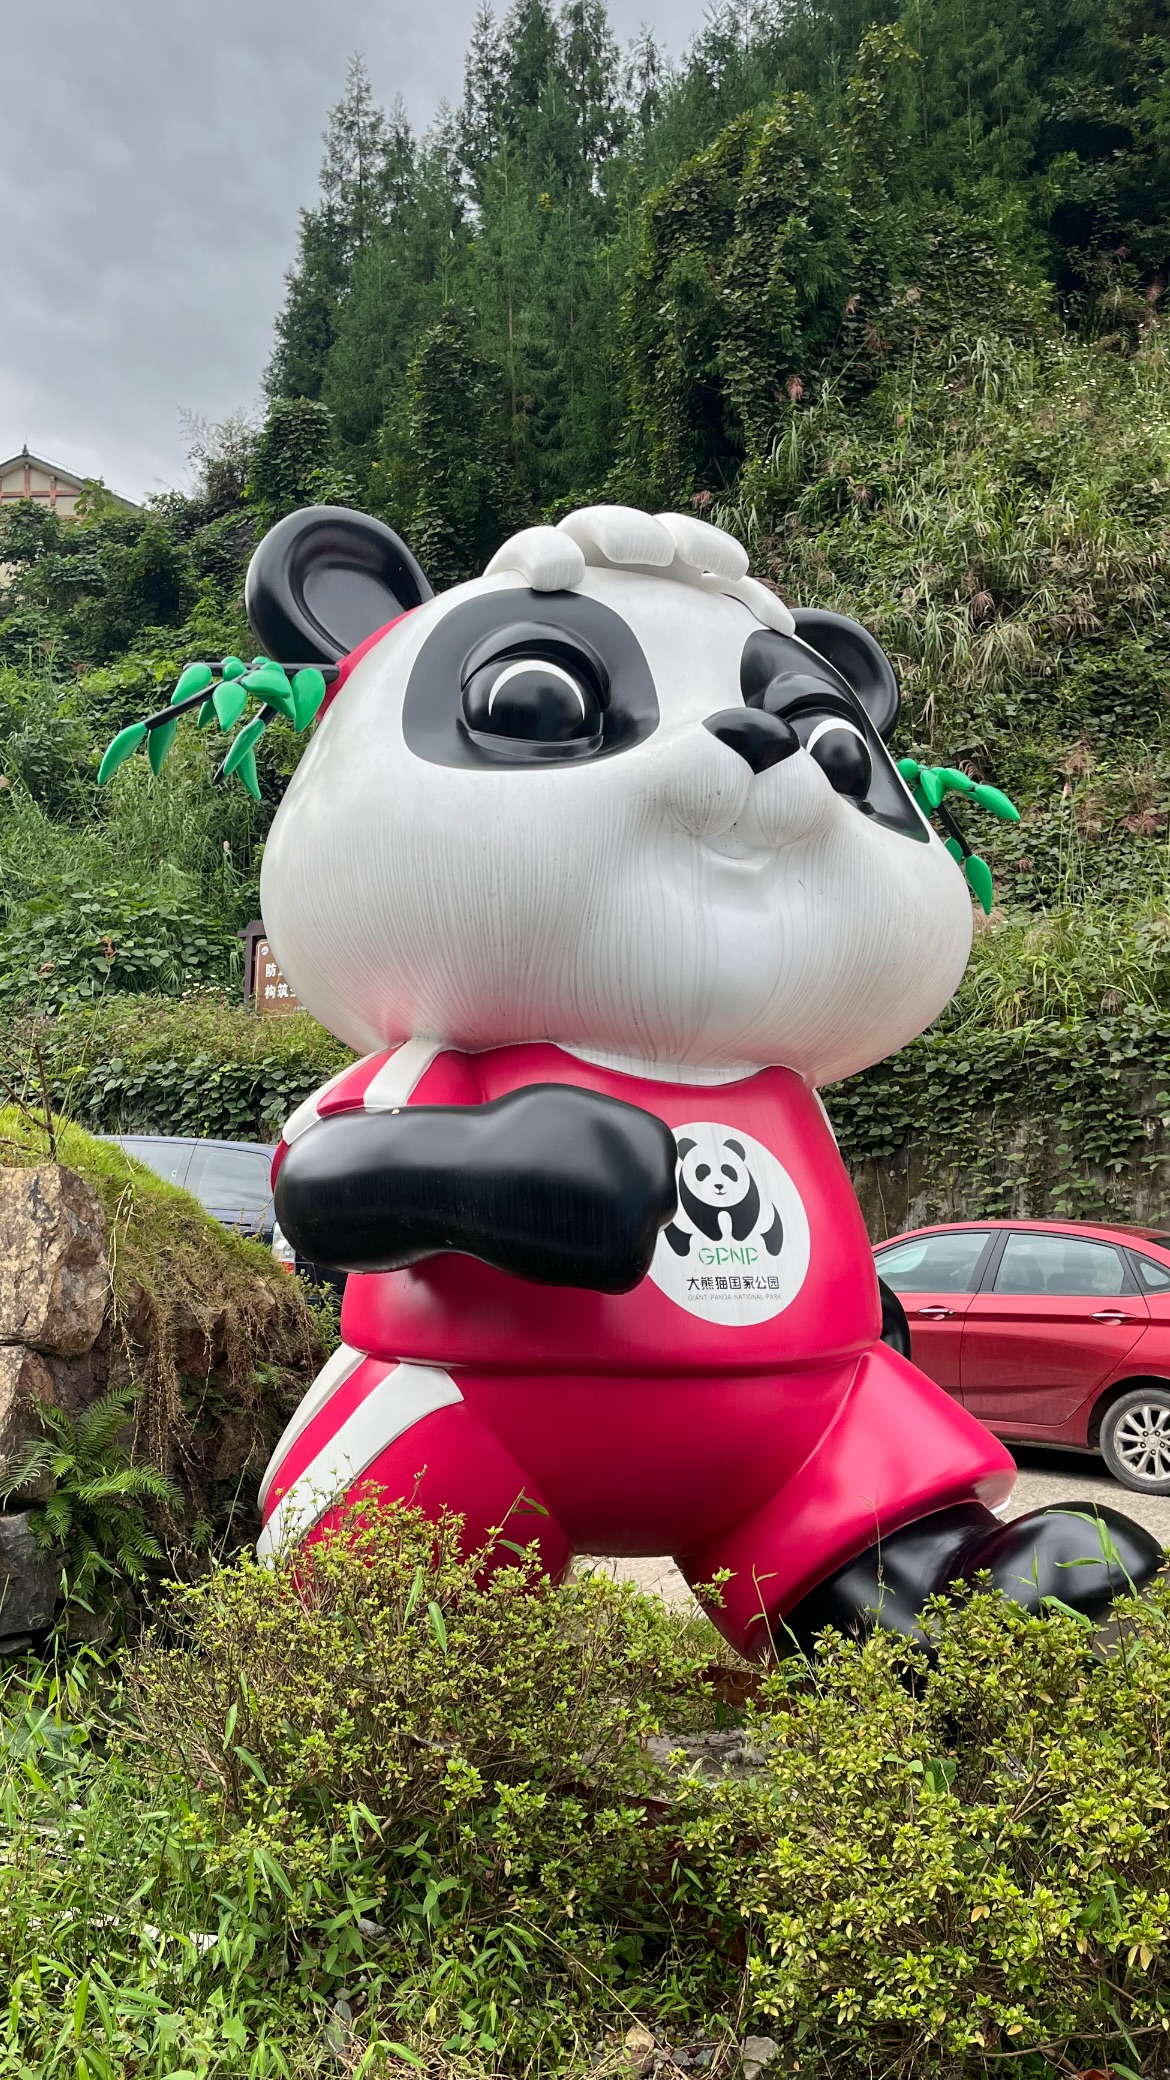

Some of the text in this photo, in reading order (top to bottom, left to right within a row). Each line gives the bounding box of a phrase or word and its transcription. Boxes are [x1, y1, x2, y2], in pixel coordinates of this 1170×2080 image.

[265, 963, 283, 978] 防
[698, 1247, 759, 1266] GPNP
[686, 1275, 780, 1291] 大熊猫国家公园
[734, 1293, 763, 1301] NATIONAL
